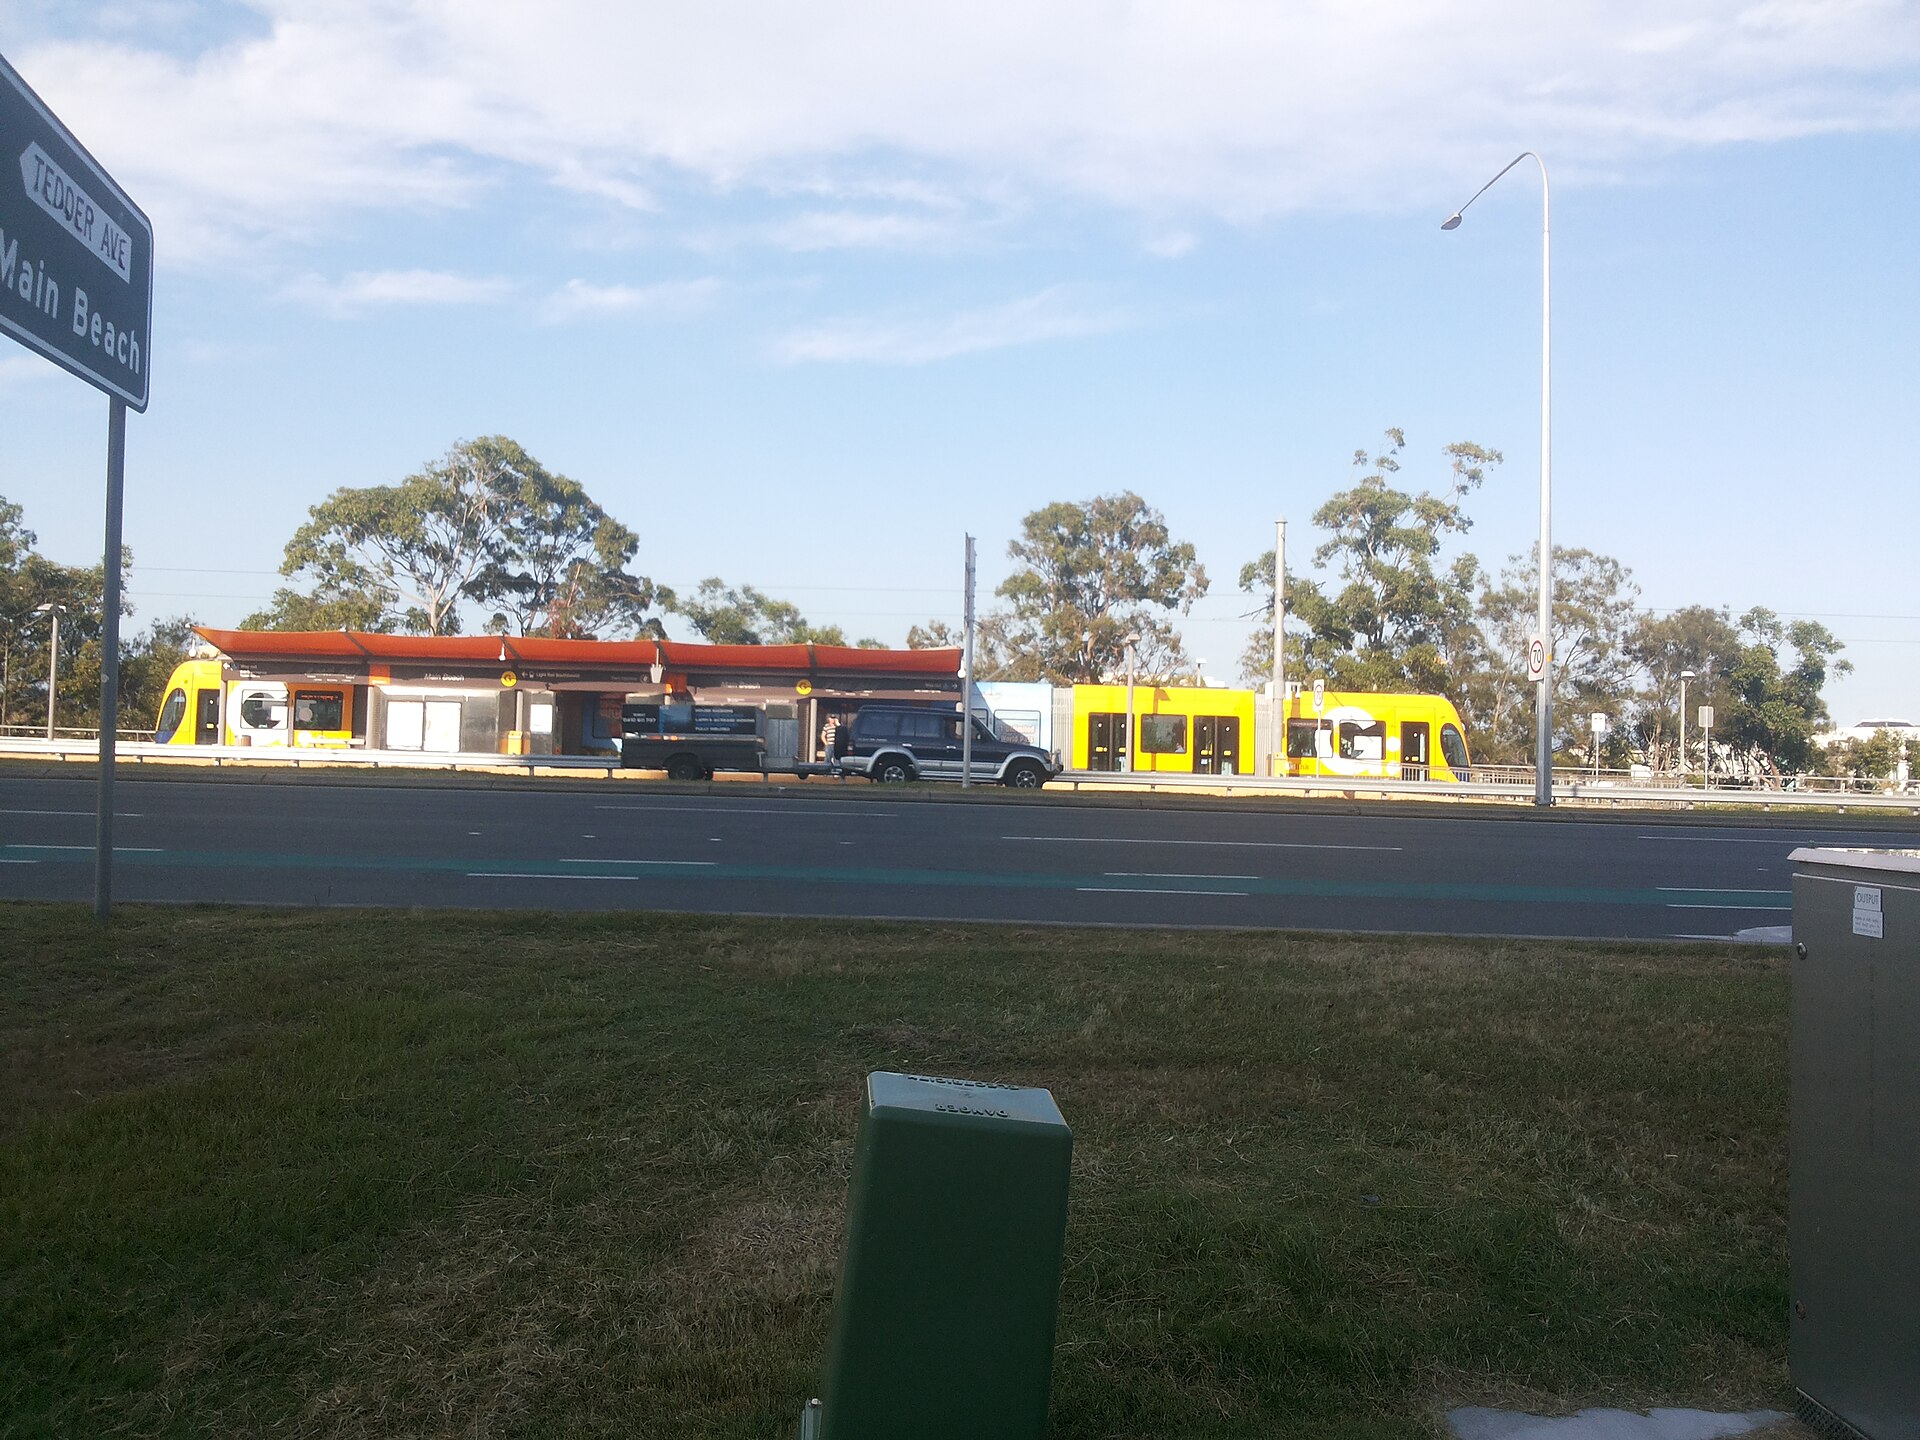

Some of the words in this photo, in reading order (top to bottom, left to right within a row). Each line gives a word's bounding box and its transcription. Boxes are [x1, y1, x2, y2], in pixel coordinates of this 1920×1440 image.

[34, 154, 95, 241] TEDDER
[100, 222, 127, 271] AVE
[72, 286, 140, 375] Beach
[1533, 648, 1542, 664] 70
[1856, 892, 1879, 905] OUTPUT
[935, 1103, 1009, 1118] DANGER
